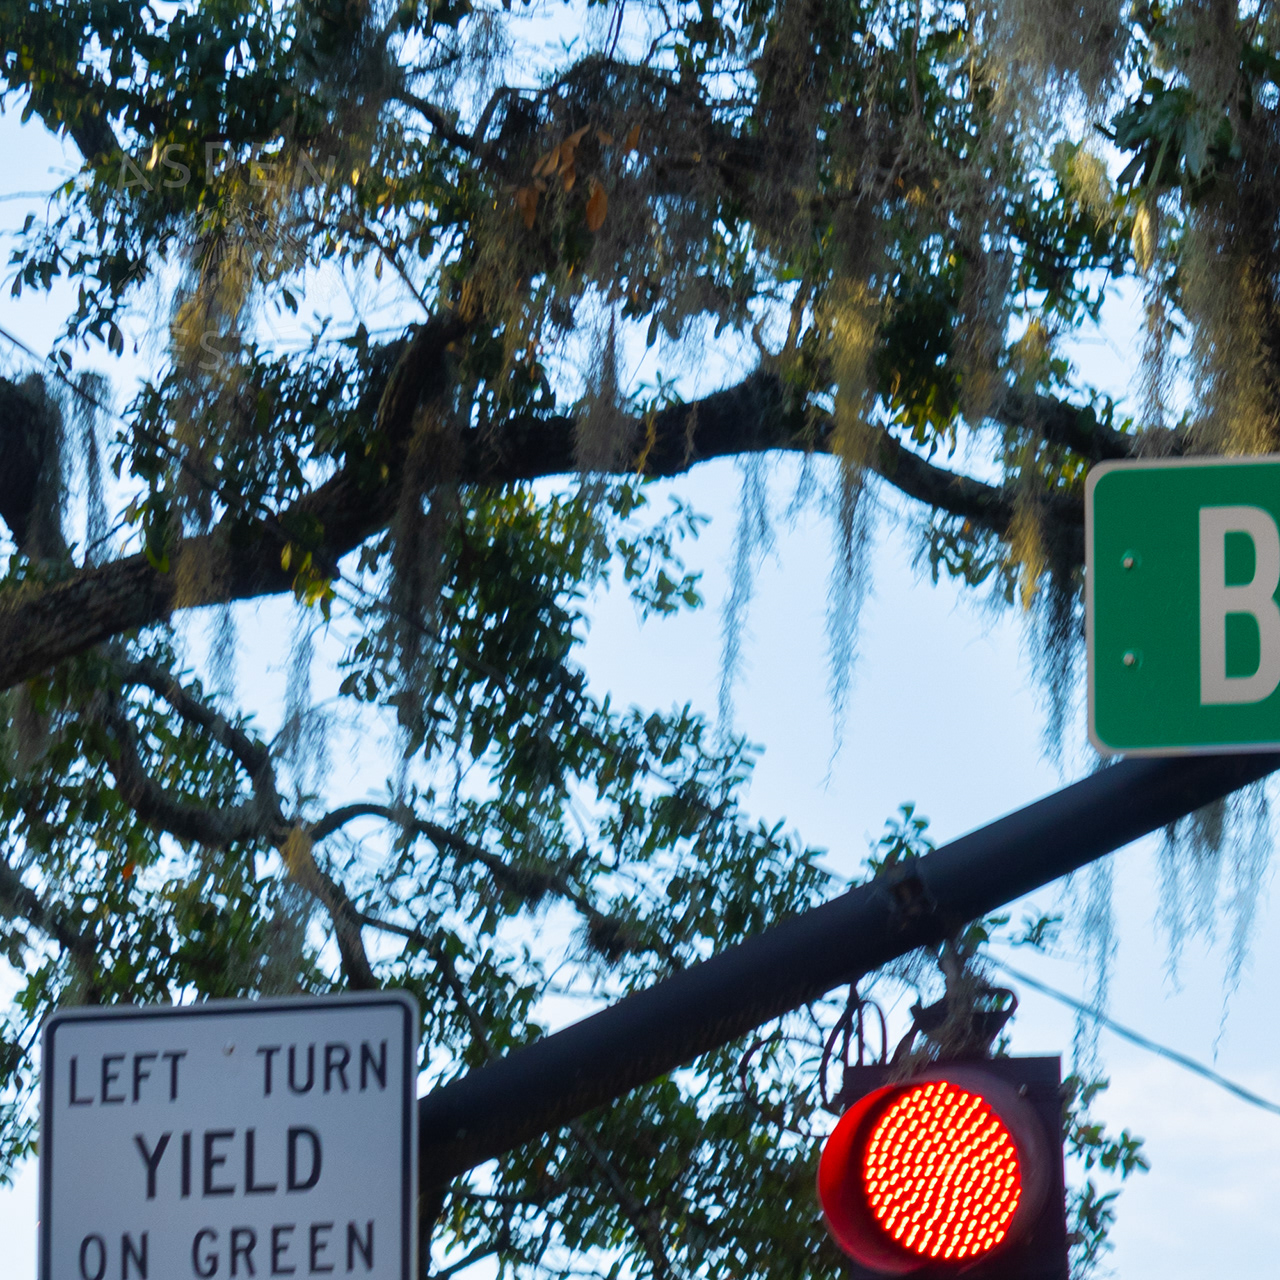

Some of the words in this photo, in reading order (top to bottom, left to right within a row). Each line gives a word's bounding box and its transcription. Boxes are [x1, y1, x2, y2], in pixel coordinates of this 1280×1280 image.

[68, 1050, 188, 1107] LEFT
[256, 1040, 388, 1097] TURN
[134, 1125, 323, 1200] YIELD
[191, 1220, 375, 1280] GREEN
